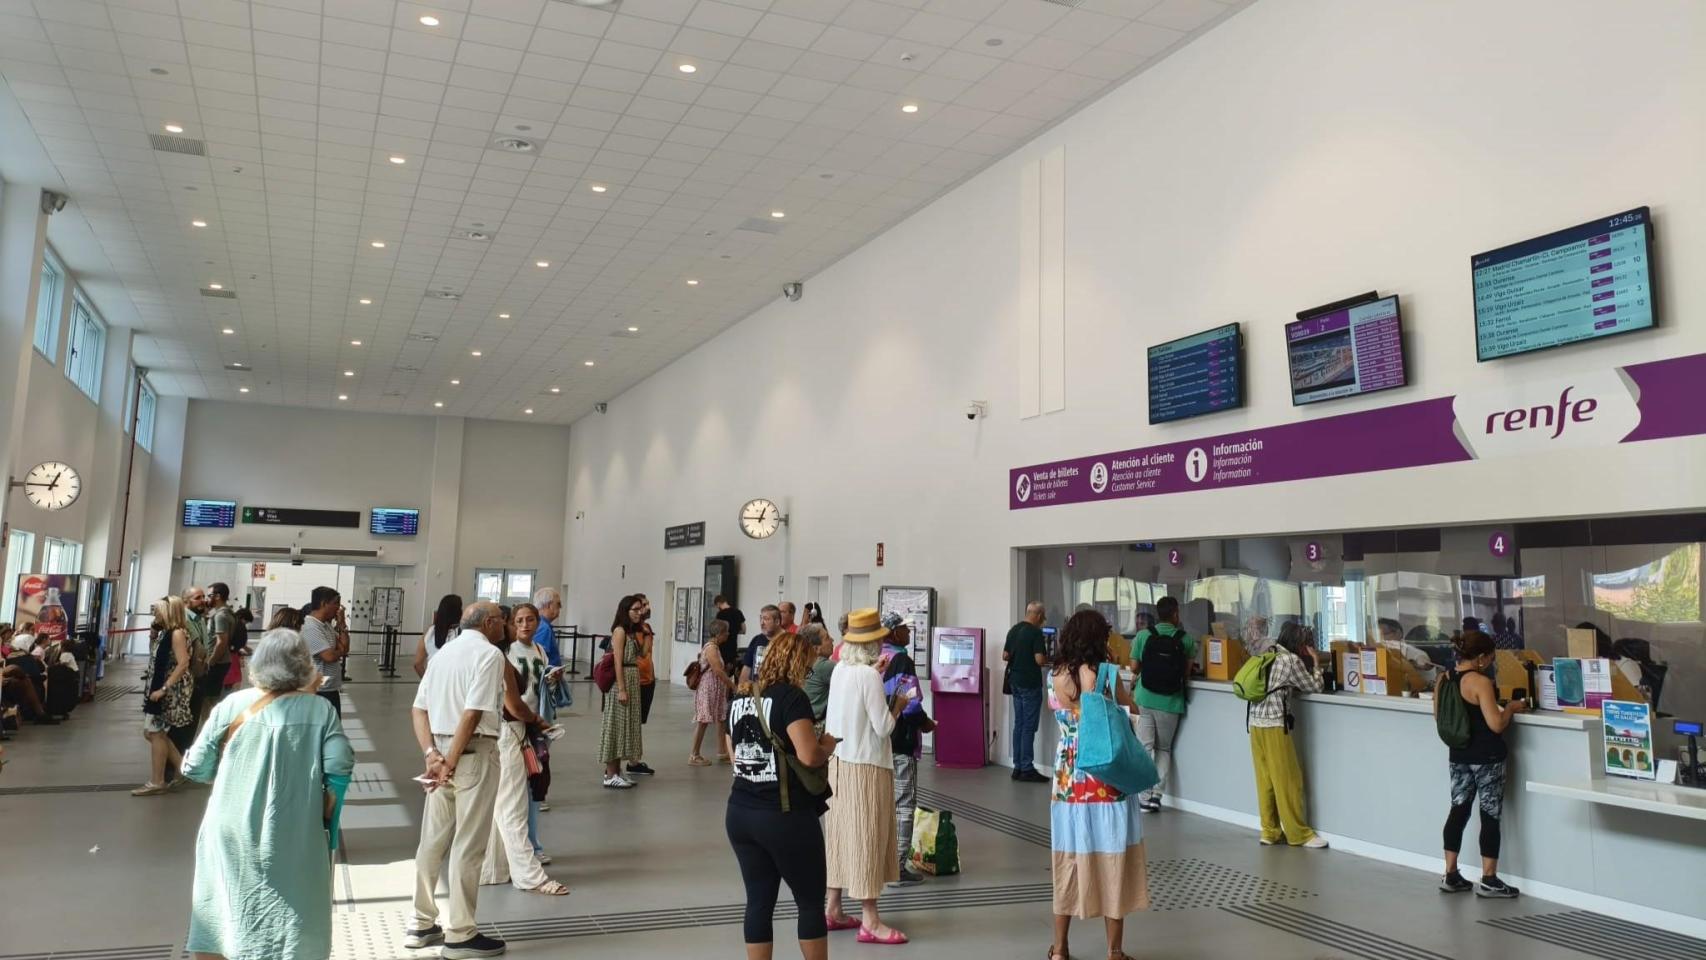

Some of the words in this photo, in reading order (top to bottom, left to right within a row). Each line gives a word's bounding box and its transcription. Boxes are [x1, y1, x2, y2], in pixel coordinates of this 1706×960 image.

[1550, 242, 1586, 257] Campoamor
[1493, 276, 1515, 285] Ourense
[1496, 315, 1512, 324] Ferrol
[1496, 328, 1518, 336] Ourense
[1486, 386, 1597, 439] renfe
[1213, 438, 1263, 456] Información
[1112, 456, 1140, 471] Atención
[1142, 454, 1148, 466] al
[1150, 452, 1175, 465] cliente
[1213, 454, 1252, 469] Información
[1033, 471, 1048, 481] Venta
[1049, 469, 1057, 479] de
[1058, 467, 1079, 477] billetes
[1112, 470, 1134, 481] Atención
[1143, 468, 1161, 478] cliente
[1213, 468, 1251, 482] Information
[1047, 482, 1052, 490] de
[1112, 482, 1136, 492] Customer
[1136, 479, 1156, 489] Service
[1047, 490, 1056, 500] sale
[1494, 536, 1504, 552] 4
[1172, 551, 1178, 563] 2
[1309, 544, 1316, 559] 3
[1068, 554, 1073, 566] 1
